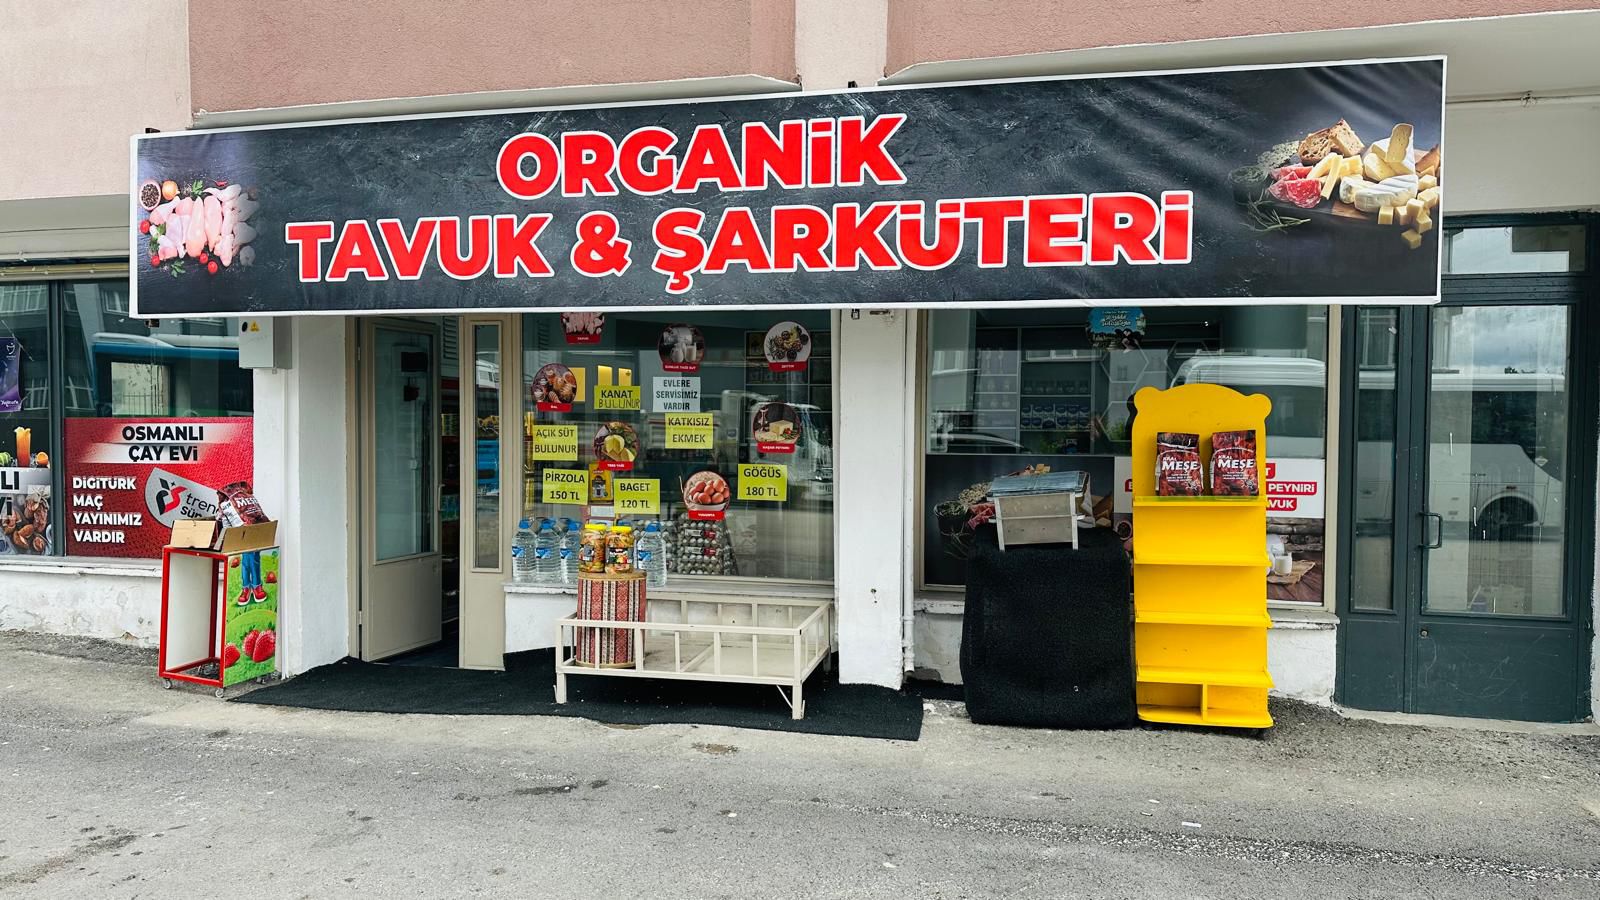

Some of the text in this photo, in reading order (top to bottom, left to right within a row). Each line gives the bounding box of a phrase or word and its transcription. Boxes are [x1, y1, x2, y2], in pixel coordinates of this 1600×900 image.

[285, 190, 1193, 294] TAVUK & ŞARKÜTERİ
[663, 379, 691, 388] EVLERE
[601, 389, 633, 399] KANAT
[656, 389, 698, 399] SERVİSİMİZ
[598, 398, 640, 409] BULUNUR
[663, 402, 691, 411] VARDIR
[668, 417, 710, 427] KATKISIZ
[122, 425, 204, 441] OSMANLI
[535, 427, 574, 438] AÇIK SÜT
[672, 433, 706, 443] EKMEK
[128, 445, 165, 462] ÇAY
[534, 444, 577, 453] BULUNUR
[1162, 460, 1198, 473] MEŞE
[1217, 458, 1255, 471] MEŞE
[545, 472, 585, 483] PİRZOLA
[743, 466, 781, 478] GÖĞÜS
[620, 482, 651, 492] BAGET
[746, 486, 778, 497] 180 TL
[550, 490, 580, 501] 150 TL
[73, 495, 104, 510] MAÇ
[186, 493, 219, 515] tren
[621, 499, 651, 509] 120 TL
[1266, 499, 1295, 509] VUK
[72, 512, 143, 527] YAYINIMIZ
[73, 530, 125, 544] VARDIR
